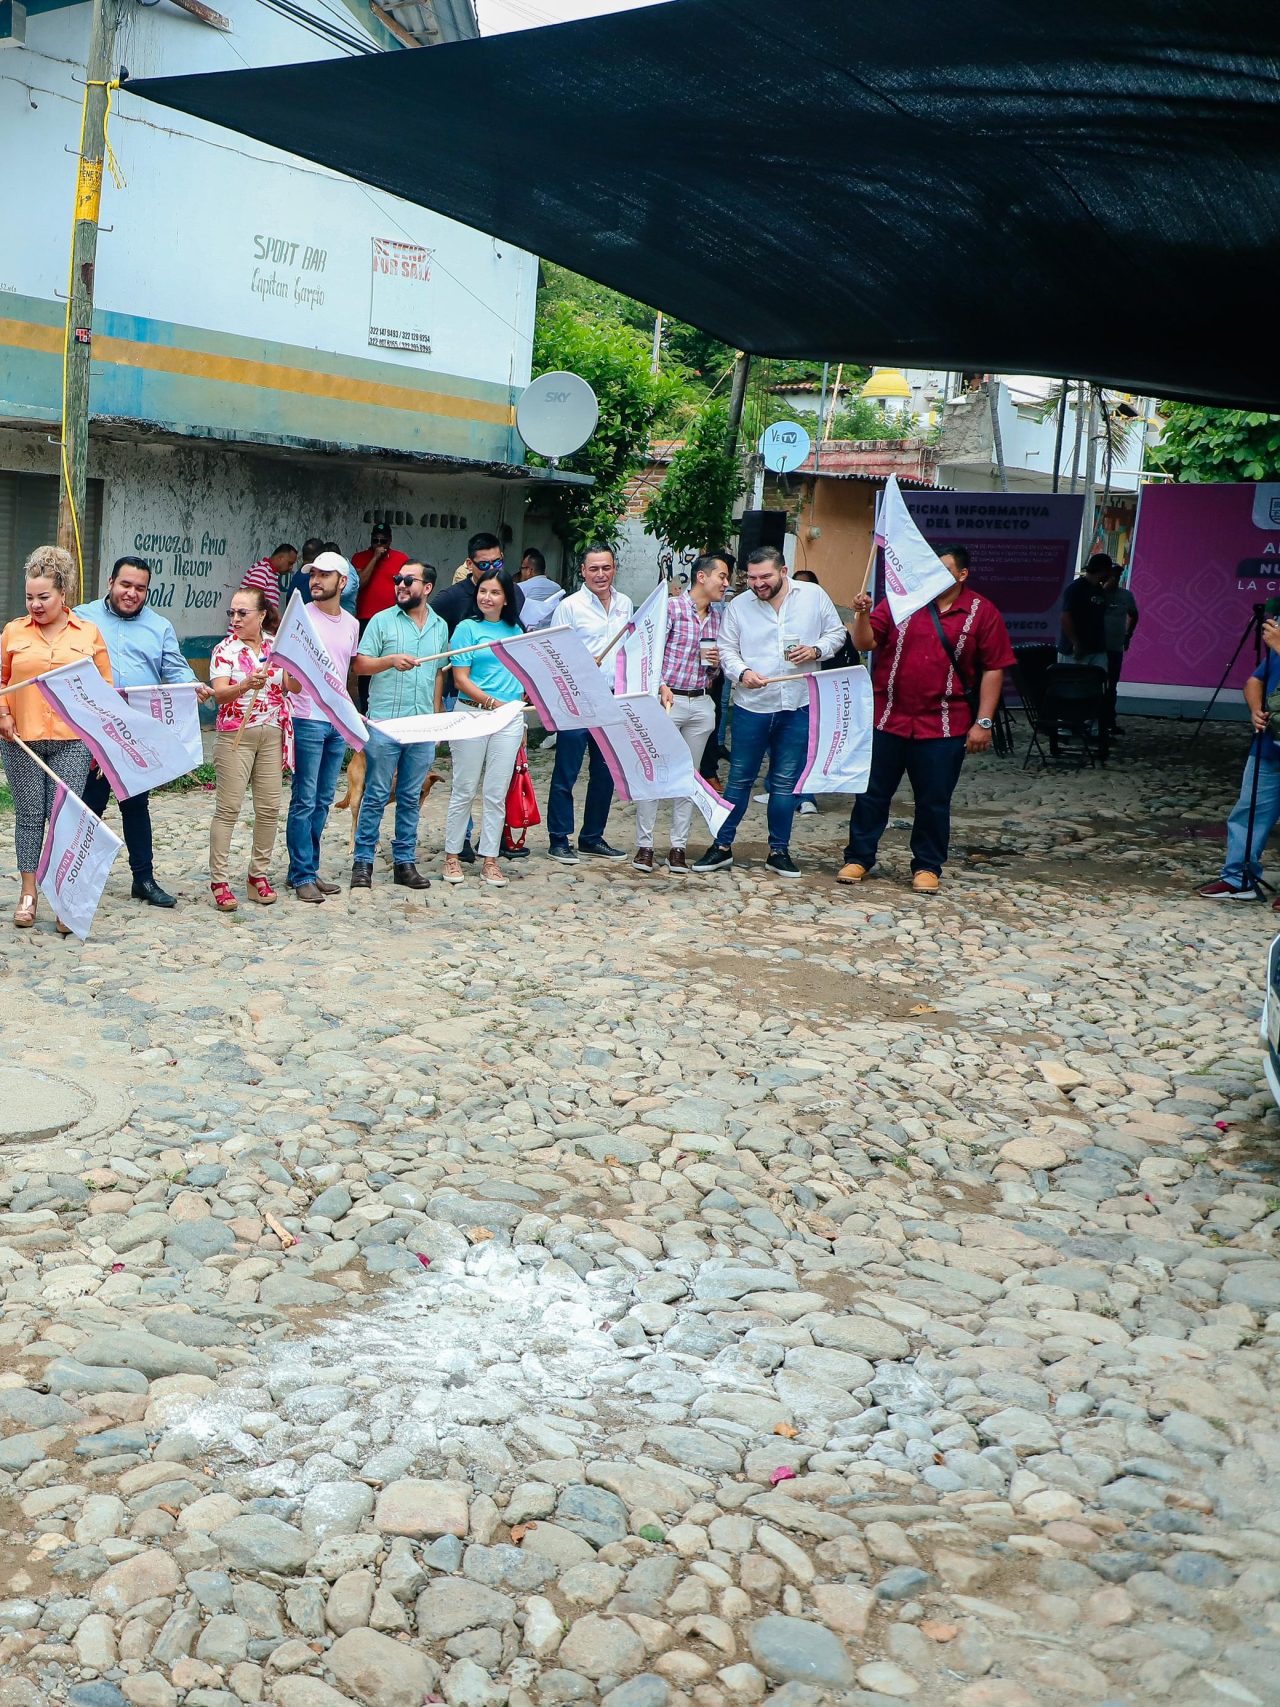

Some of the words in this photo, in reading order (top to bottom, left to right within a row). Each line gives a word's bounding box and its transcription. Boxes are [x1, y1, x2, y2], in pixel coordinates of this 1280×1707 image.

[254, 234, 300, 266] SPORT
[301, 246, 328, 272] BAR
[545, 391, 571, 403] SKY
[909, 505, 949, 514] FICHA
[954, 506, 1050, 517] INFORMATIVA
[926, 519, 951, 528] DEL
[956, 520, 1030, 530] PROYECTO
[185, 583, 222, 609] beer
[1238, 580, 1257, 590] LA
[1006, 621, 1048, 630] OYECTO
[539, 638, 581, 697] Trabajamos
[72, 674, 137, 746] Trabajamos
[835, 678, 852, 755] Trabajamos
[619, 702, 660, 760] Trabajamos
